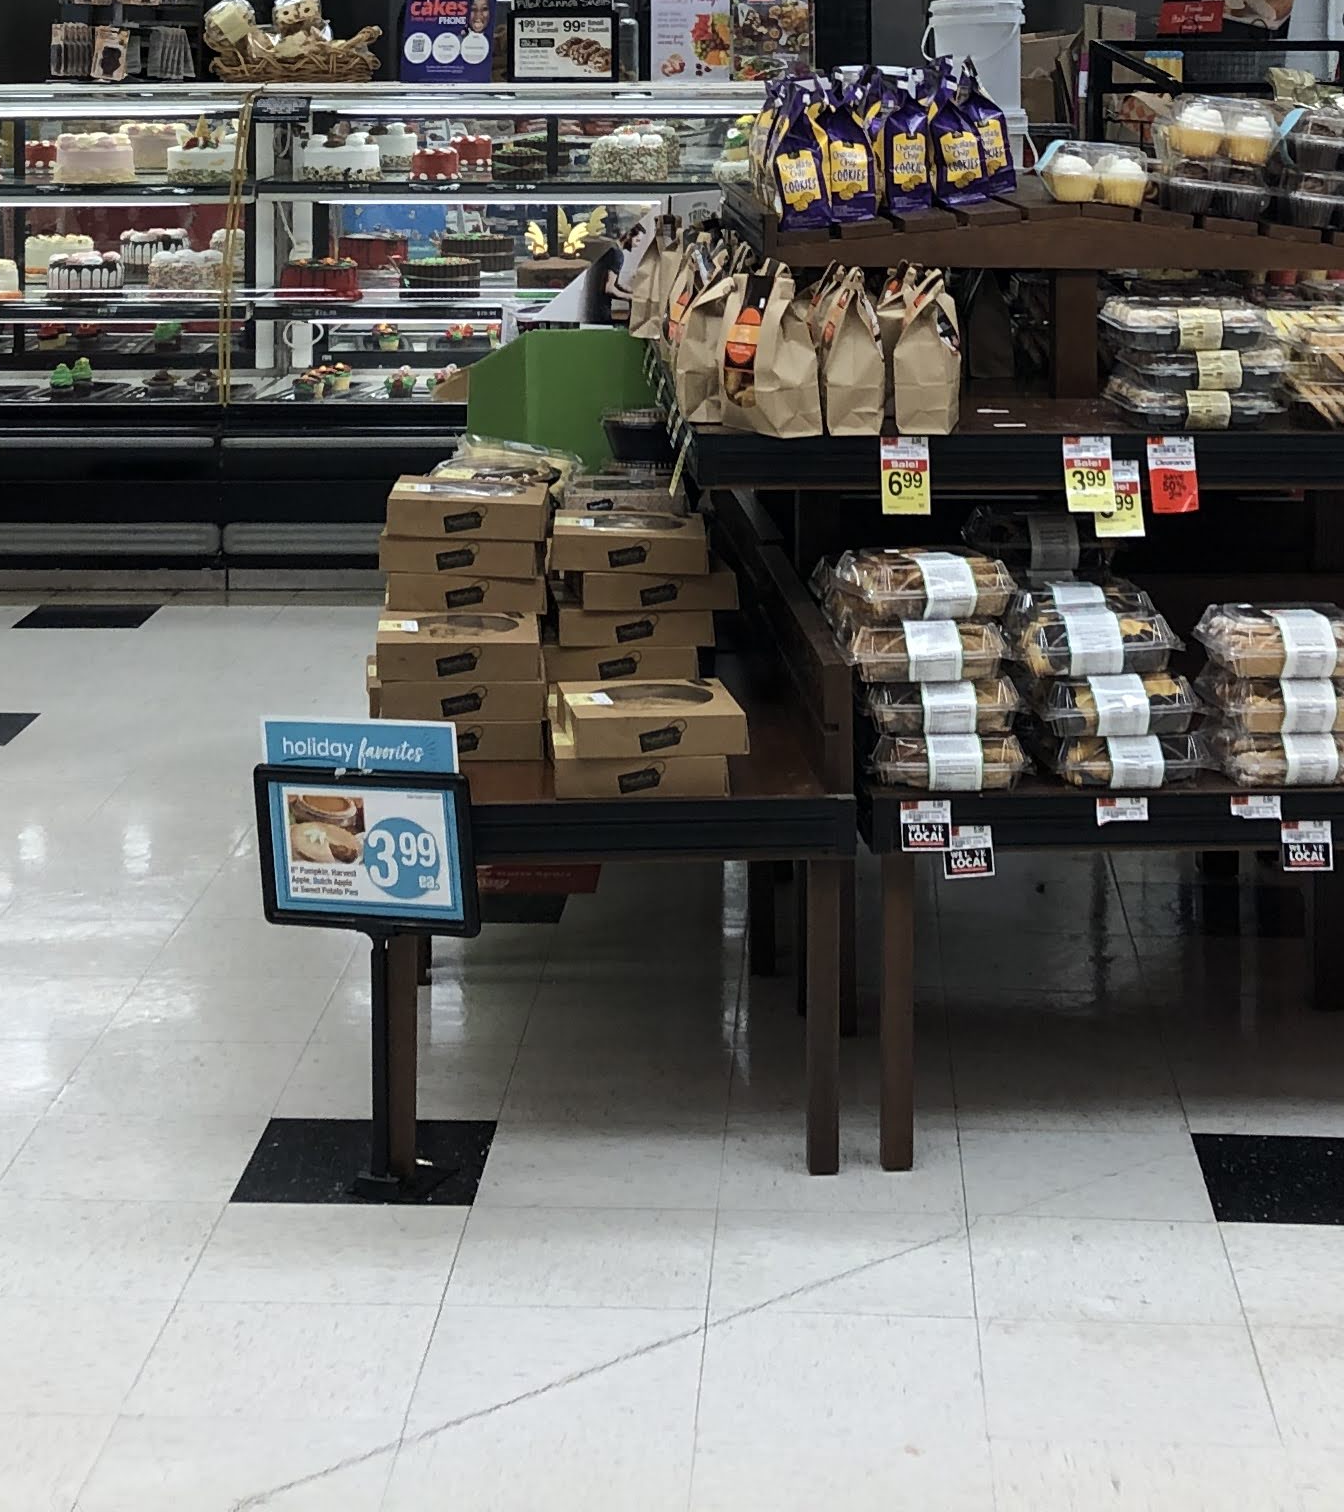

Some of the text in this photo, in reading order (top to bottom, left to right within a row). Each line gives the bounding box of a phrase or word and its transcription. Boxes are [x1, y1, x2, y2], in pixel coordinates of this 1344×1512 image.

[438, 17, 467, 25] PHONE
[948, 158, 979, 173] COOKIES
[833, 169, 866, 183] COOKIES
[784, 178, 817, 194] COOKIES
[891, 460, 919, 469] Sale!
[1074, 459, 1102, 468] Sale!
[1155, 459, 1192, 467] Clearance
[888, 471, 923, 496] 699
[1072, 470, 1107, 491] 399
[282, 737, 424, 770] holiday favorites
[908, 832, 944, 842] LOCAL
[367, 829, 437, 888] 399
[951, 857, 987, 869] LOCAL
[1289, 852, 1325, 861] LOCAL
[419, 875, 440, 891] ea.
